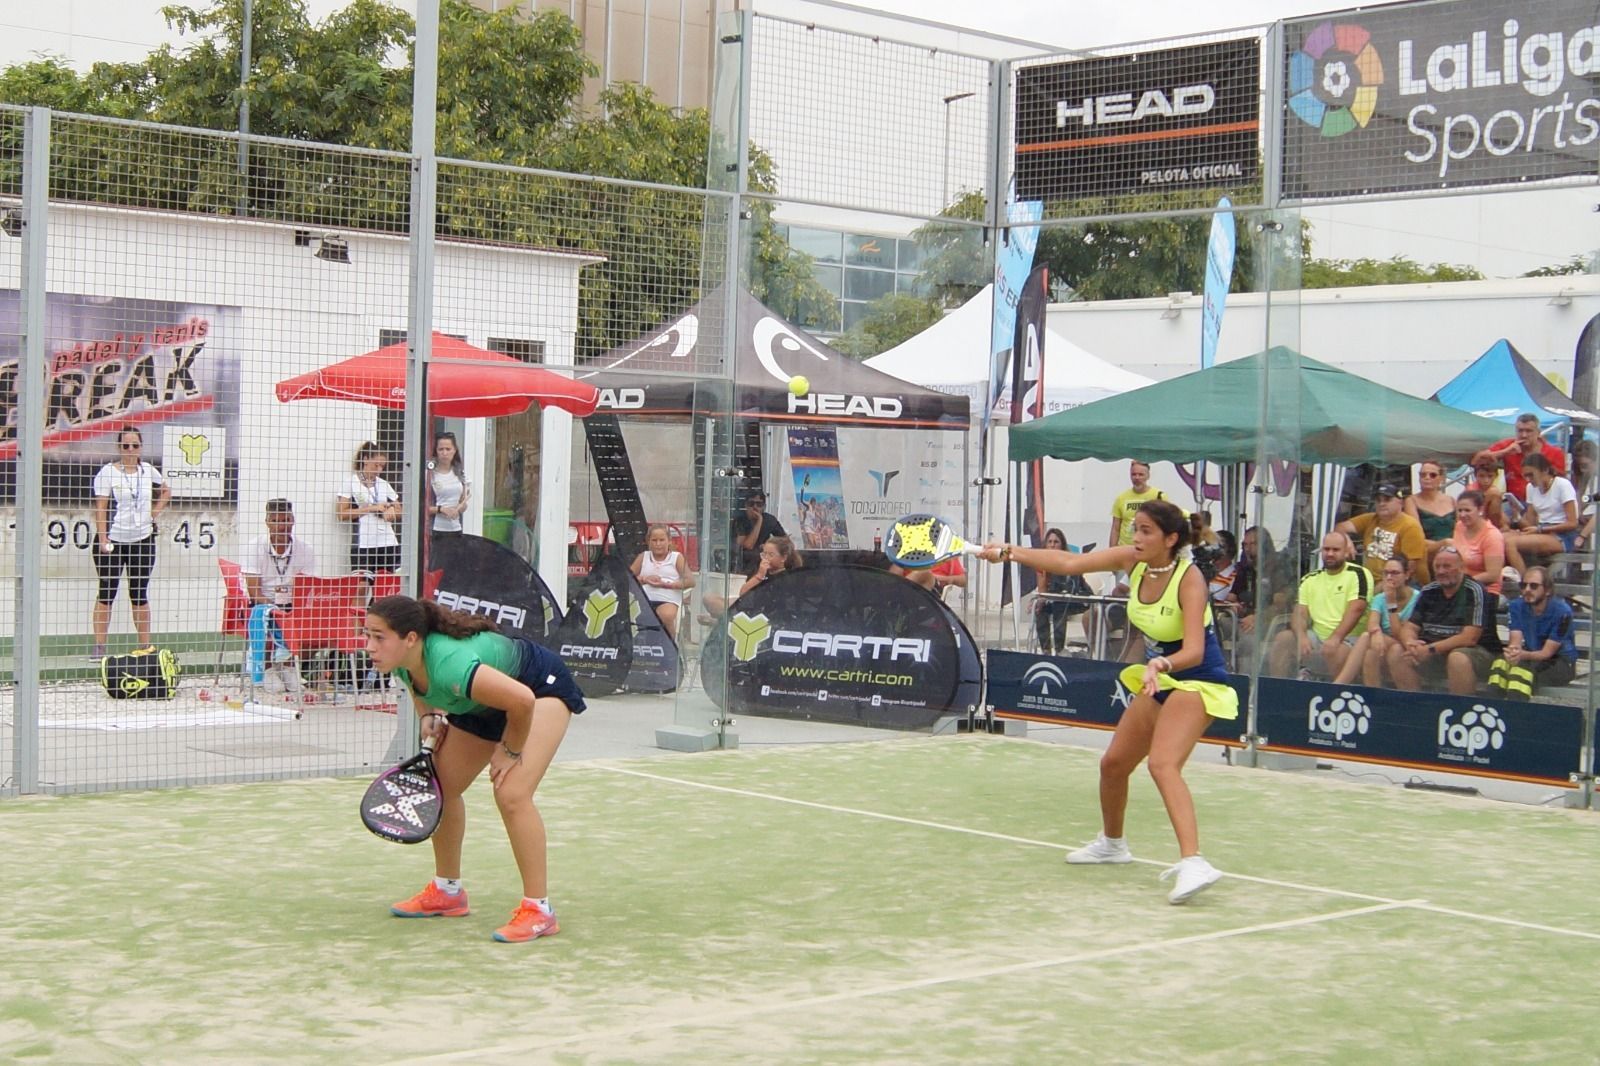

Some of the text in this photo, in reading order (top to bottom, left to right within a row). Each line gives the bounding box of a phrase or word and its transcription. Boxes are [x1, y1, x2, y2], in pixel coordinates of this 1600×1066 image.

[1398, 18, 1600, 97] LaLiga
[1056, 84, 1215, 128] HEAD
[1404, 92, 1600, 178] Sports
[1141, 163, 1243, 184] PELOTA OFICIAL
[596, 388, 645, 408] AD
[787, 392, 902, 418] HEAD
[167, 470, 220, 478] CARTRI
[48, 520, 215, 549] 90 45
[434, 589, 527, 629] ARTRI
[560, 644, 619, 660] CARTRI
[773, 630, 931, 663] CARTRI
[780, 665, 913, 686] www.cartri.com
